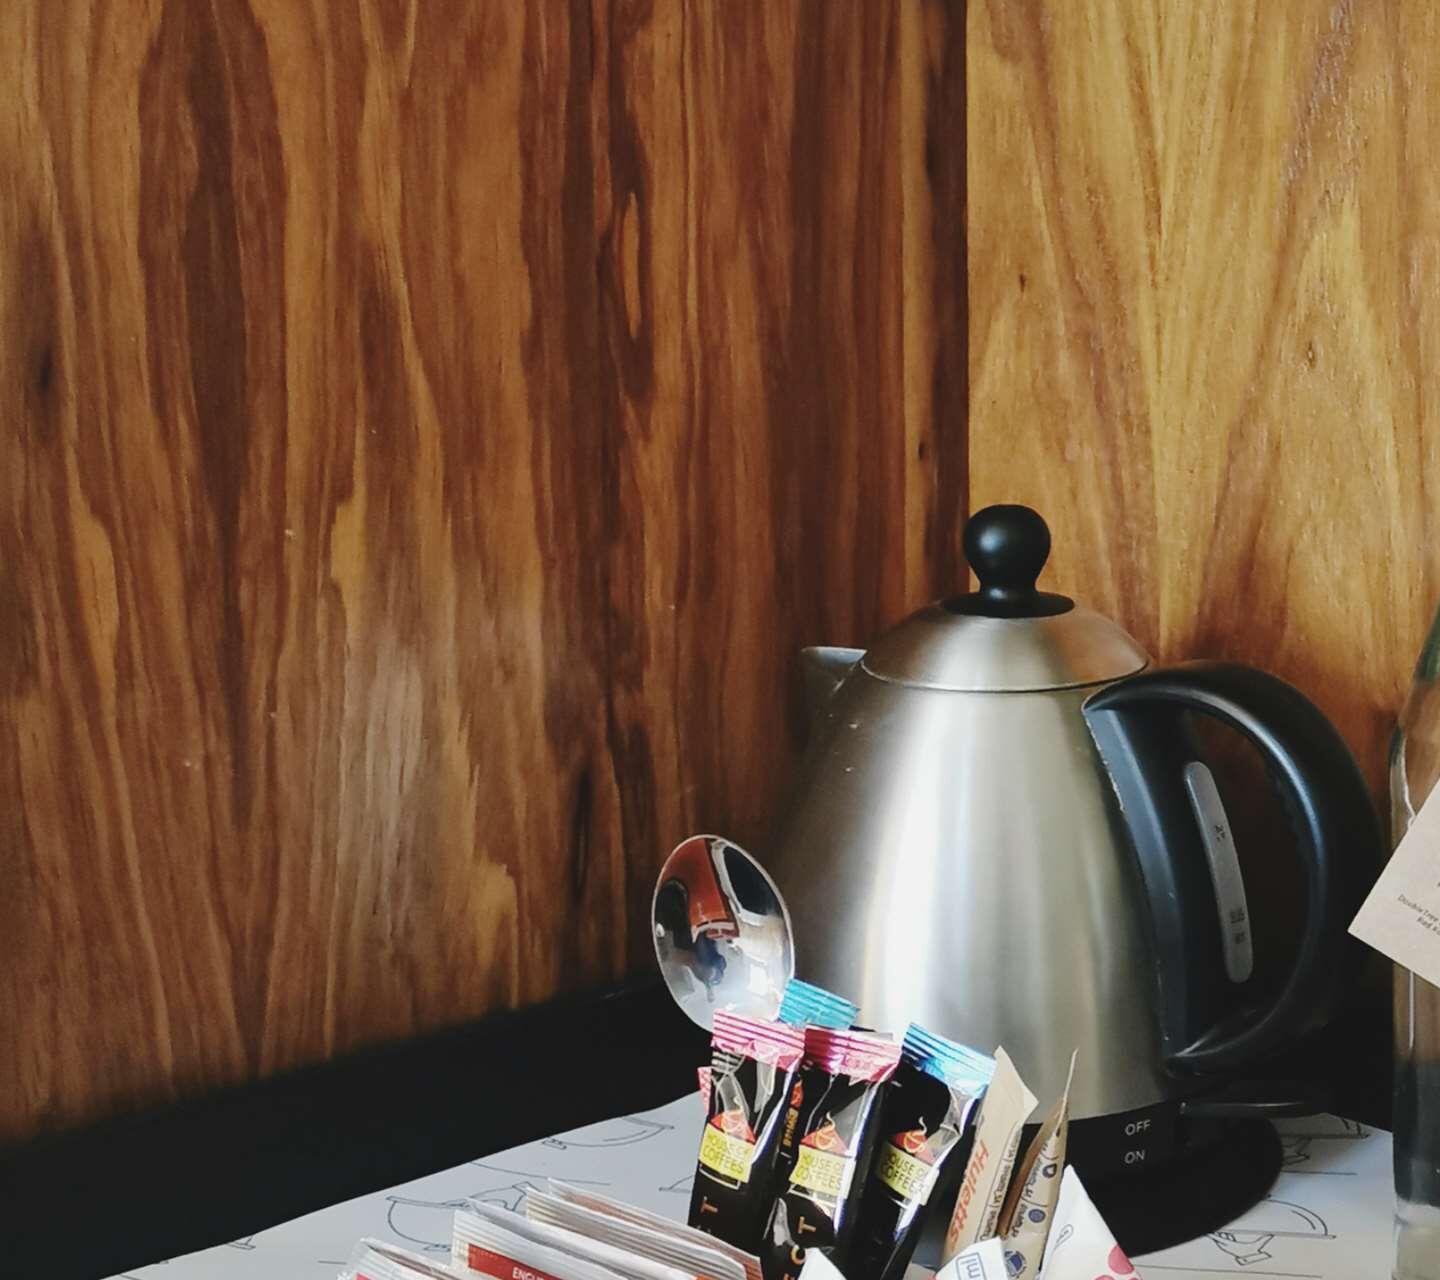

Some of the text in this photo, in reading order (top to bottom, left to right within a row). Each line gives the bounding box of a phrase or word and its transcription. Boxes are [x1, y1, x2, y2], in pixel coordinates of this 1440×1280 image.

[1125, 1119, 1151, 1136] OFF
[1124, 1149, 1145, 1164] ON
[950, 1139, 989, 1250] Huletts
[966, 1256, 984, 1279] ml
